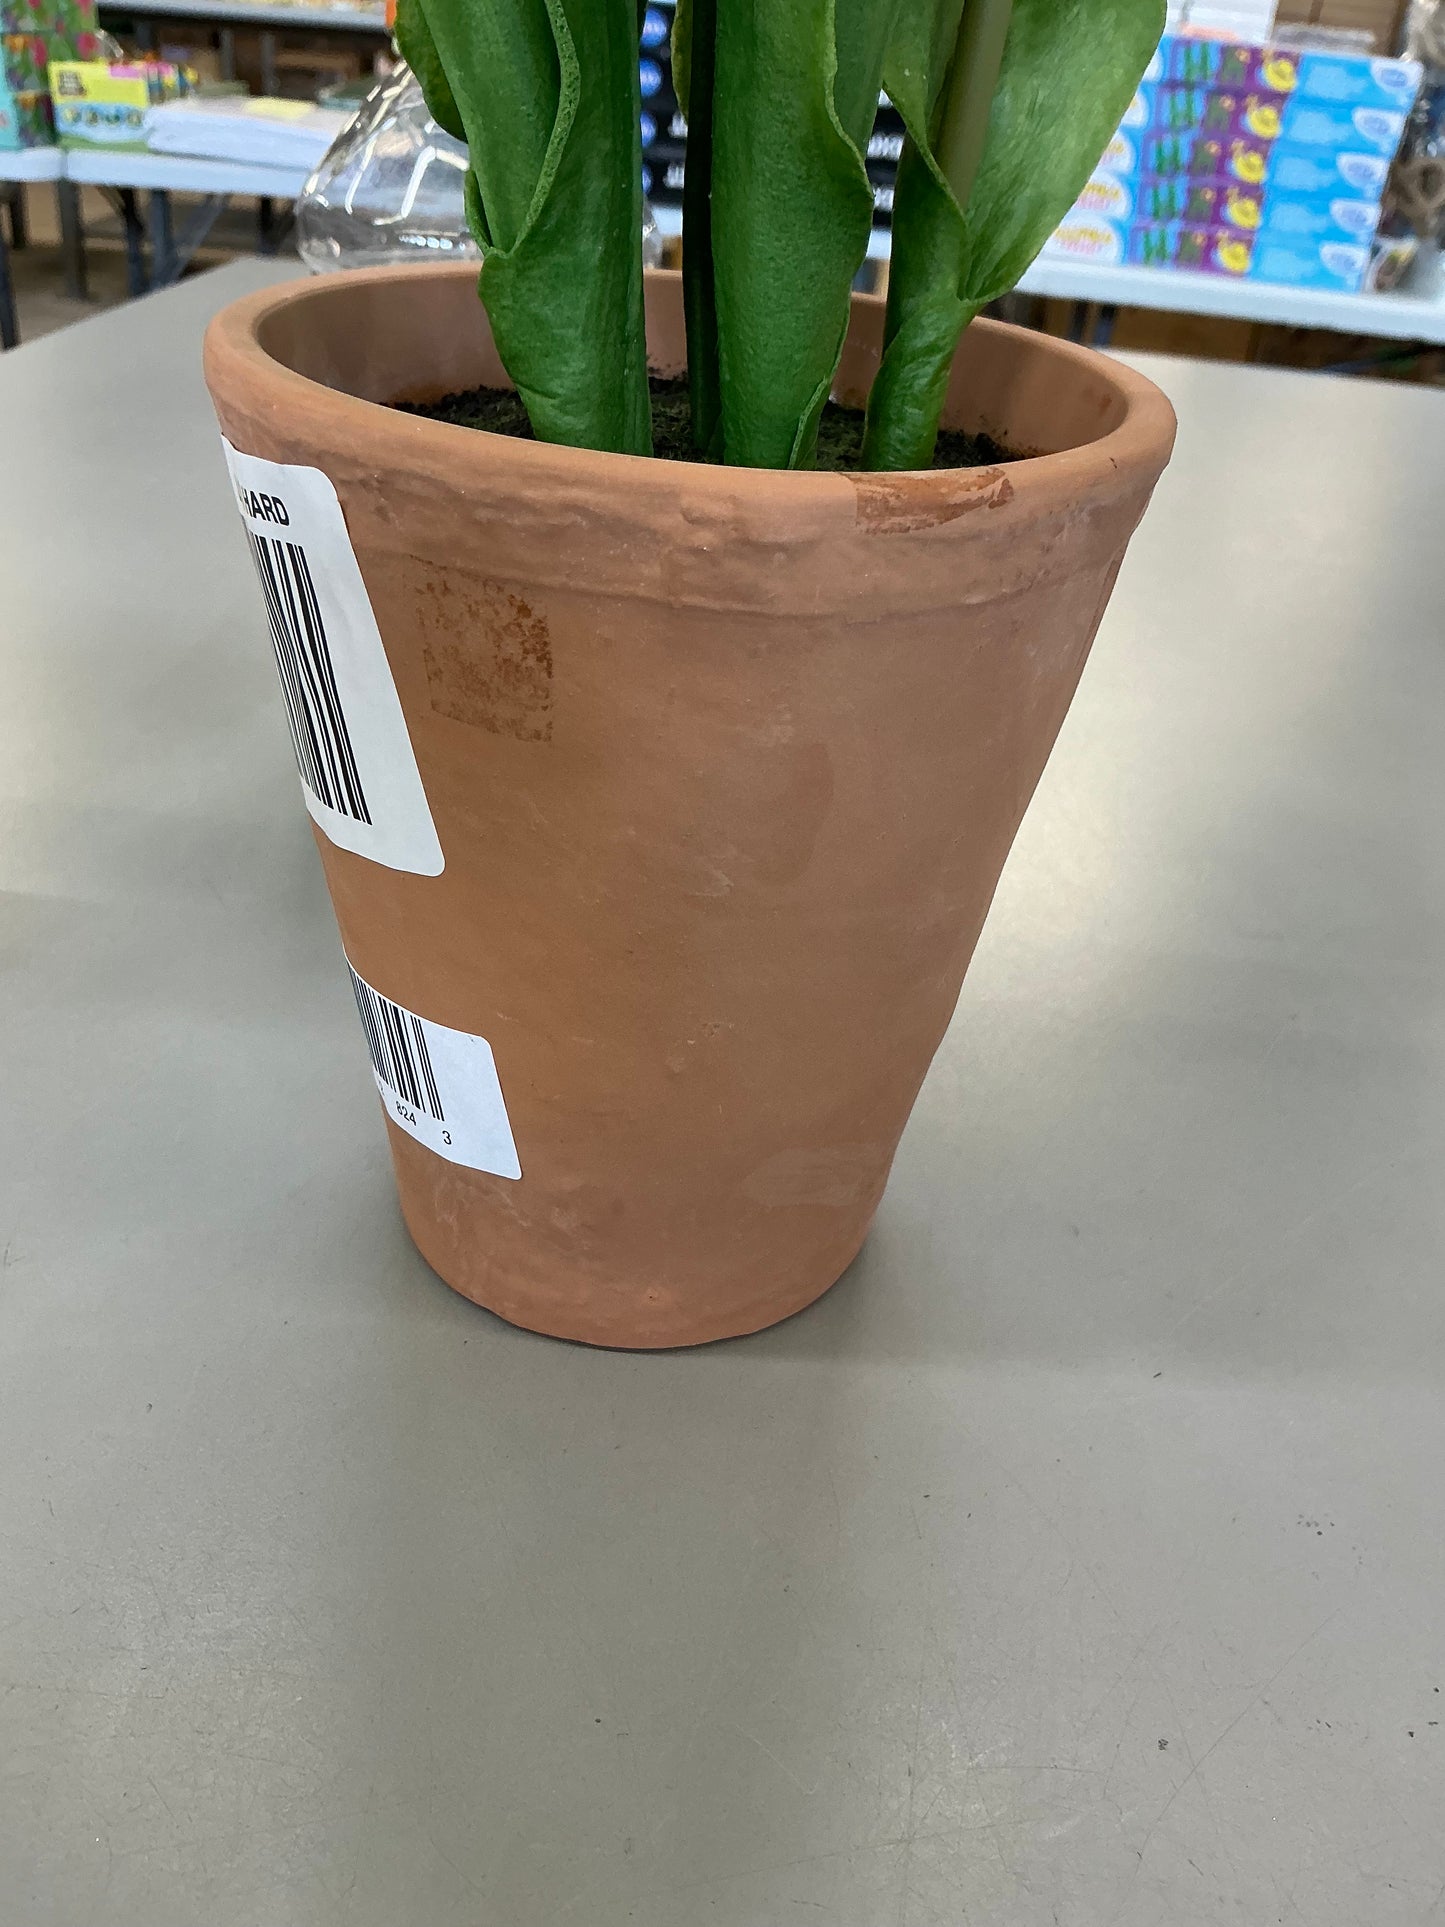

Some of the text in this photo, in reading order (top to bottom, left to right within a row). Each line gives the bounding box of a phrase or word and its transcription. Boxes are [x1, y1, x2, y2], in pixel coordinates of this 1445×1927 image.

[240, 487, 290, 526] HARD
[395, 1100, 452, 1145] 824 3
